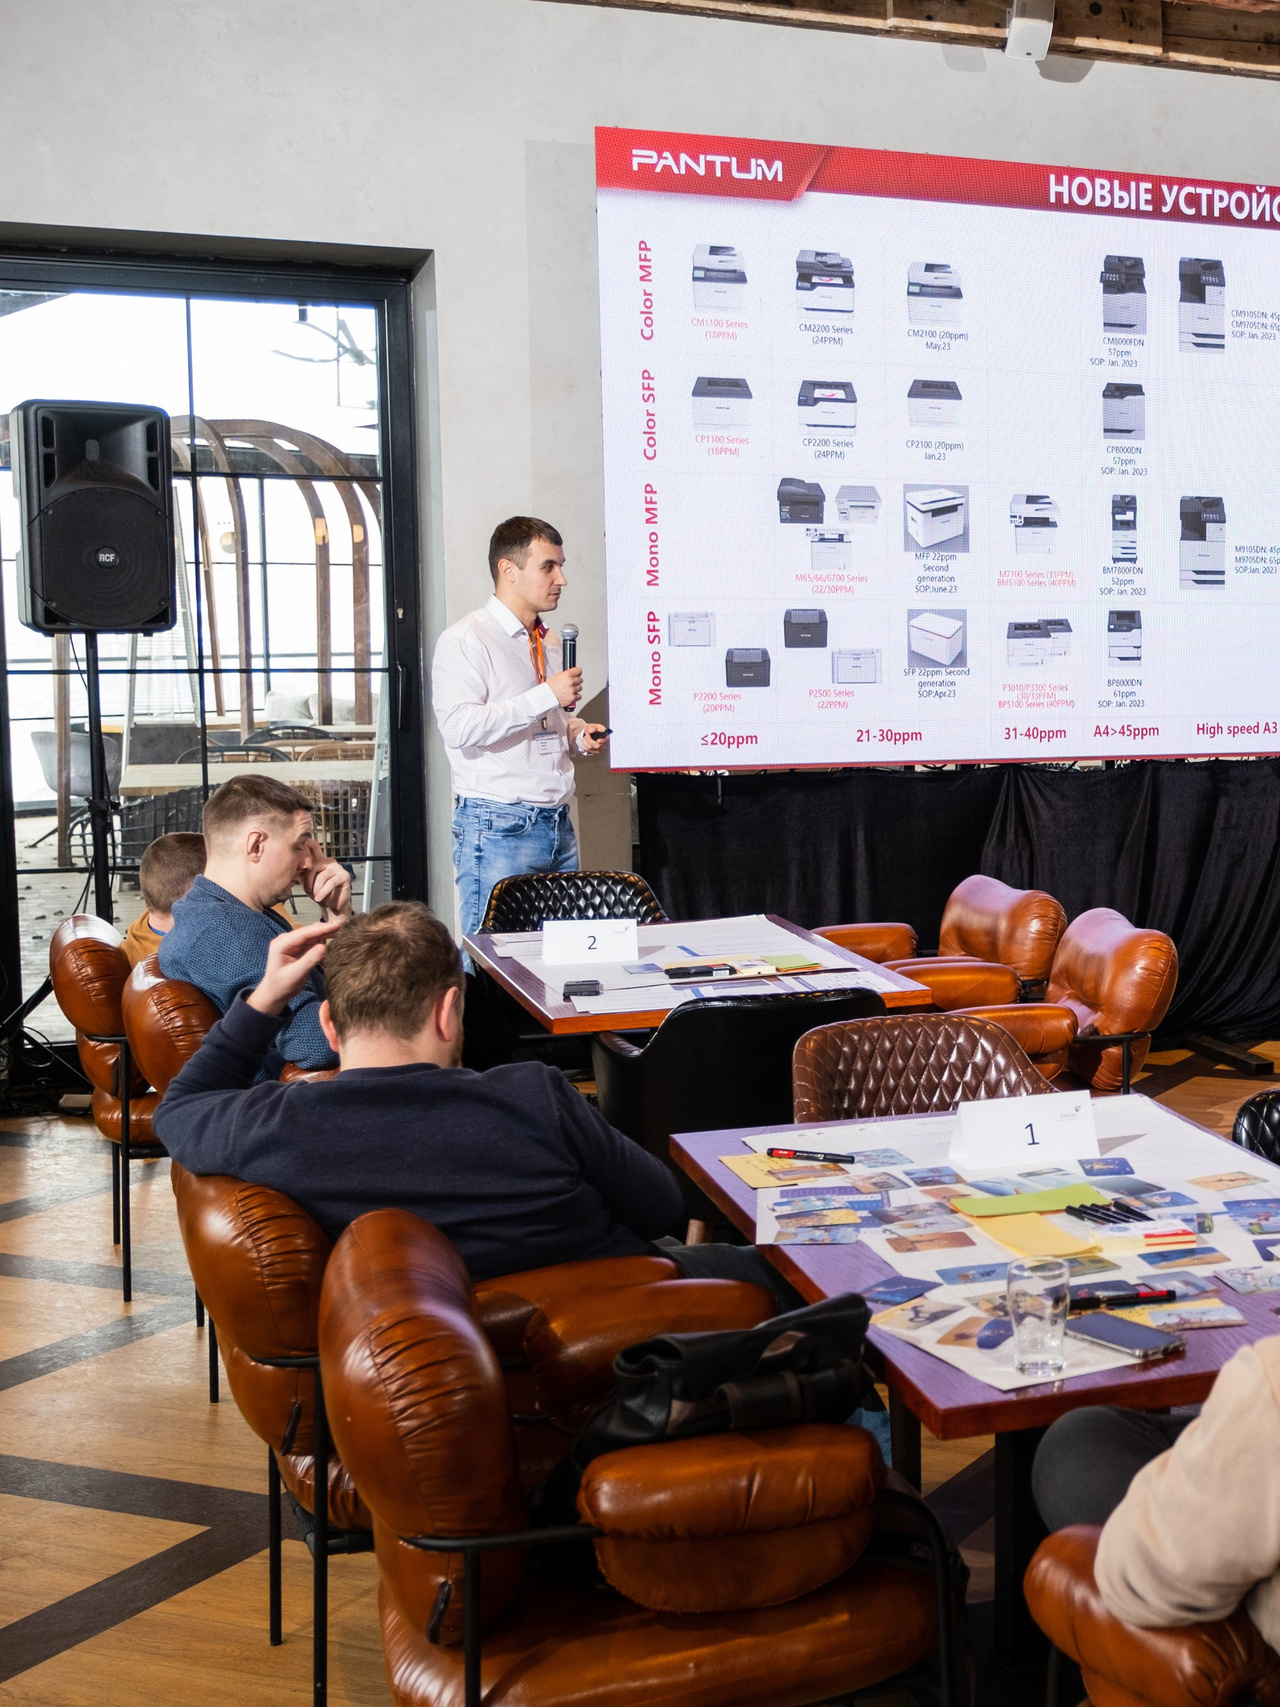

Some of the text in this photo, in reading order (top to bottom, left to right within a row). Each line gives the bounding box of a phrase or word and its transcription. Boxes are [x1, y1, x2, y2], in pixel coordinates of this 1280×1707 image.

[631, 148, 783, 182] PANTUM
[1049, 174, 1153, 212] НОВЫЕ
[638, 240, 654, 341] Color MFP
[691, 318, 748, 329] CM1100 Series
[799, 323, 854, 334] CM2200 Series
[907, 329, 969, 341] CM2100 (20ppm)
[1260, 332, 1277, 341] 2023
[812, 336, 843, 346] (24PPM)
[1108, 348, 1132, 358] 57ppm
[1121, 359, 1138, 368] 2023
[641, 369, 657, 461] Color SFP
[695, 434, 750, 445] CP1100 Series
[802, 438, 854, 449] CP2200 Series
[905, 439, 964, 451] CP2100 (20ppm)
[707, 447, 740, 457] (18PPM)
[814, 450, 845, 460] (24PPM)
[1112, 456, 1136, 467] 57ppm
[1131, 467, 1148, 476] 2023
[644, 483, 660, 587] Mono MFP
[98, 553, 115, 562] RCF
[914, 552, 957, 562] MFP 22ppm
[923, 563, 949, 572] Second
[1262, 566, 1278, 574] 2023
[846, 573, 868, 583] Series
[916, 574, 955, 584] generation
[999, 570, 1023, 578] M7100
[1024, 570, 1044, 578] Series
[1026, 579, 1047, 587] Series
[1111, 577, 1135, 587] 52ppm
[811, 585, 855, 595] (22/30PPM)
[1130, 587, 1147, 596] 2023
[647, 611, 662, 706] Mono SFP
[903, 667, 970, 678] SFP 22ppm Second
[917, 679, 956, 689] generation
[1048, 684, 1069, 692] Series
[1107, 678, 1143, 688] BP8000DN
[693, 692, 742, 701] P2200 Series
[808, 689, 855, 698] P2500 Series
[1113, 690, 1137, 699] 61ppm
[702, 704, 735, 713] (20PPM)
[817, 700, 849, 710] (22PPM)
[1024, 700, 1045, 709] Series
[1128, 700, 1145, 708] 2023
[1004, 726, 1067, 743] 31-40ppm
[1093, 724, 1160, 740] A4>45ppm
[1196, 721, 1278, 738] High speed A3
[856, 729, 923, 745] 21-30ppm
[587, 935, 597, 950] 2
[1025, 1123, 1040, 1145] 1
